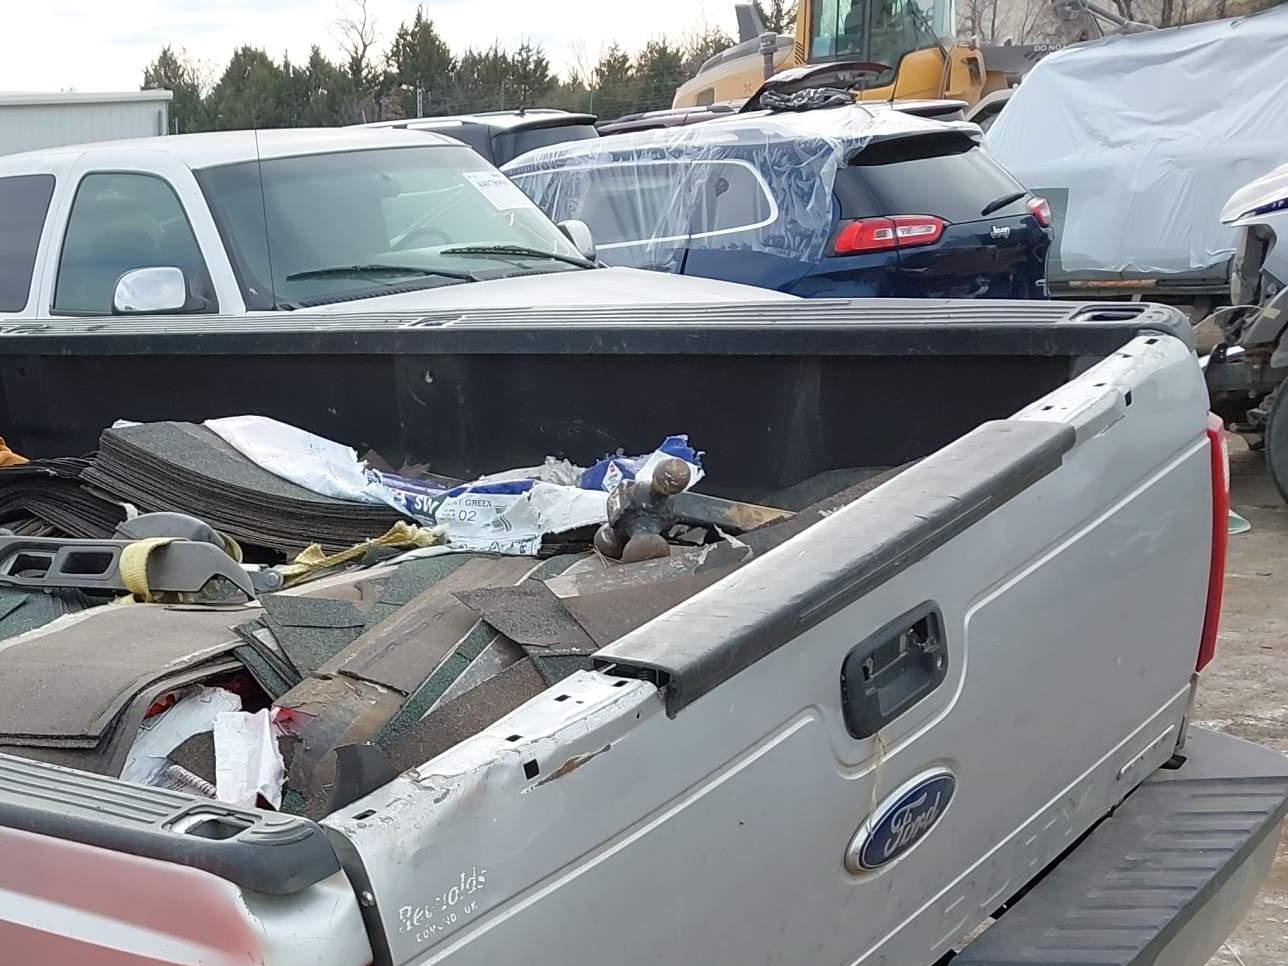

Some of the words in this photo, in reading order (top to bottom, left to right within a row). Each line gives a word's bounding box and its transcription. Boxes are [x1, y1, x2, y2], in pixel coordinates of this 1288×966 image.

[458, 509, 477, 522] 02
[464, 499, 492, 508] GREEN
[883, 791, 941, 858] Ford
[927, 783, 1095, 951] DUTY
